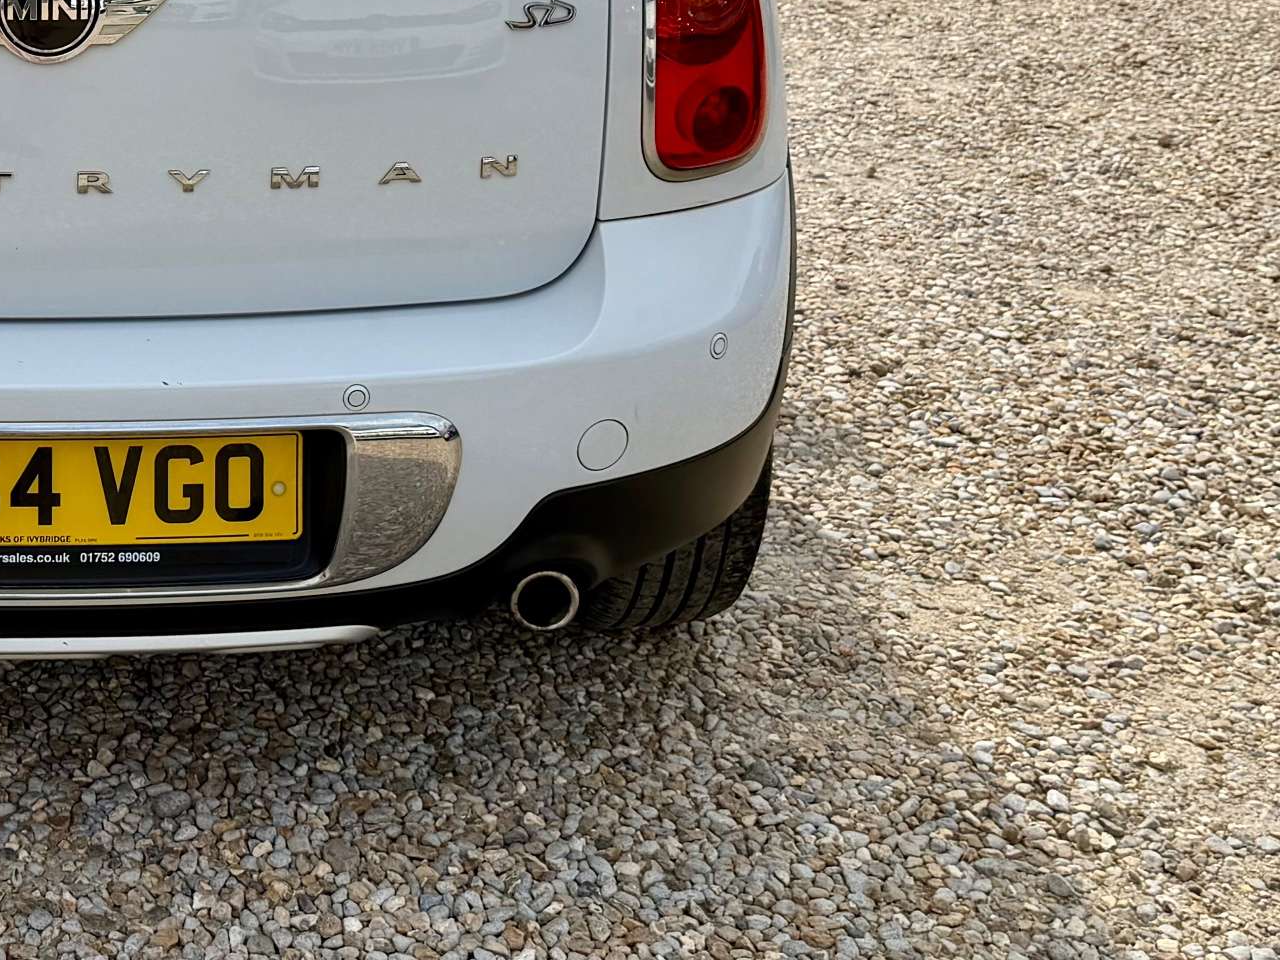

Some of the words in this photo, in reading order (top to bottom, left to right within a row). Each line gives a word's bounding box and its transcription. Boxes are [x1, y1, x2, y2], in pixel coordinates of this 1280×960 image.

[93, 442, 265, 526] VGO
[13, 535, 24, 543] OF
[26, 535, 71, 543] IVYBRIDGE
[80, 552, 115, 563] 01752
[118, 552, 160, 563] 690609
